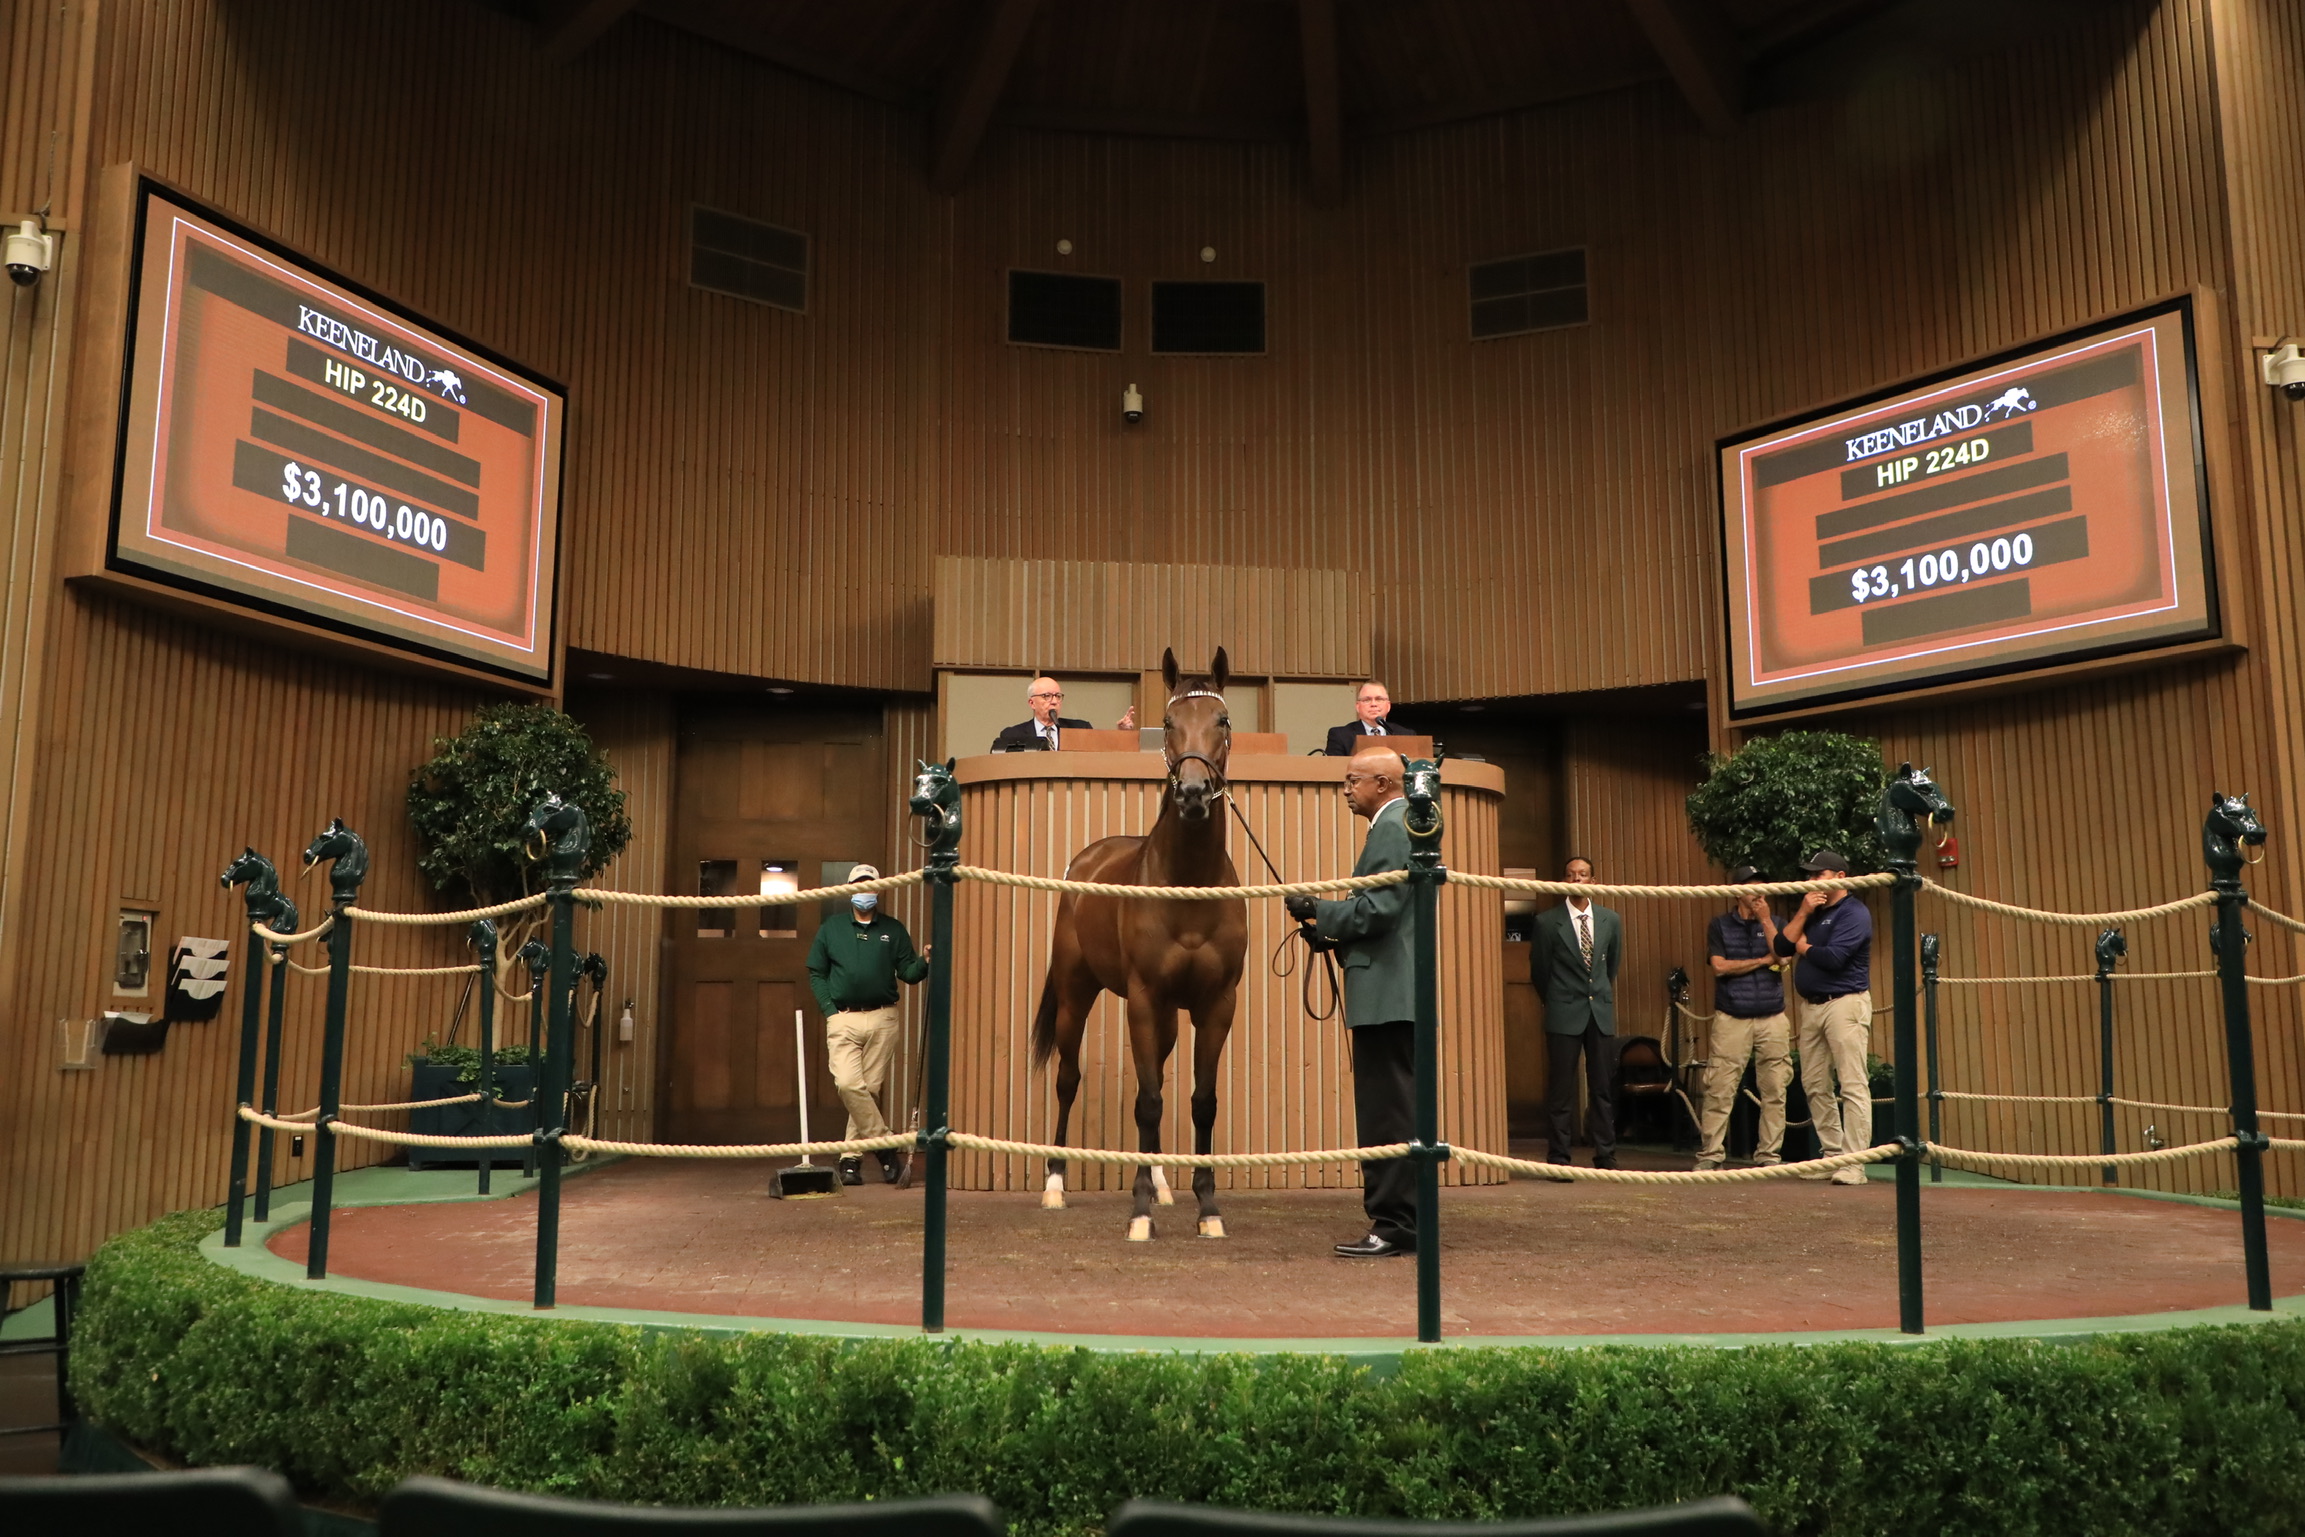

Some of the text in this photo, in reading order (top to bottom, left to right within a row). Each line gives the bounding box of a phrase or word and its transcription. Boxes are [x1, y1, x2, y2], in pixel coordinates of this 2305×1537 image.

[298, 305, 425, 383] KEENELAND
[325, 358, 427, 423] HIP 224D
[1846, 404, 1983, 462] KEENELAND
[1877, 438, 1989, 487] HIP 224D
[282, 462, 447, 551] $3,100,000
[1851, 533, 2033, 603] $3,100,000
